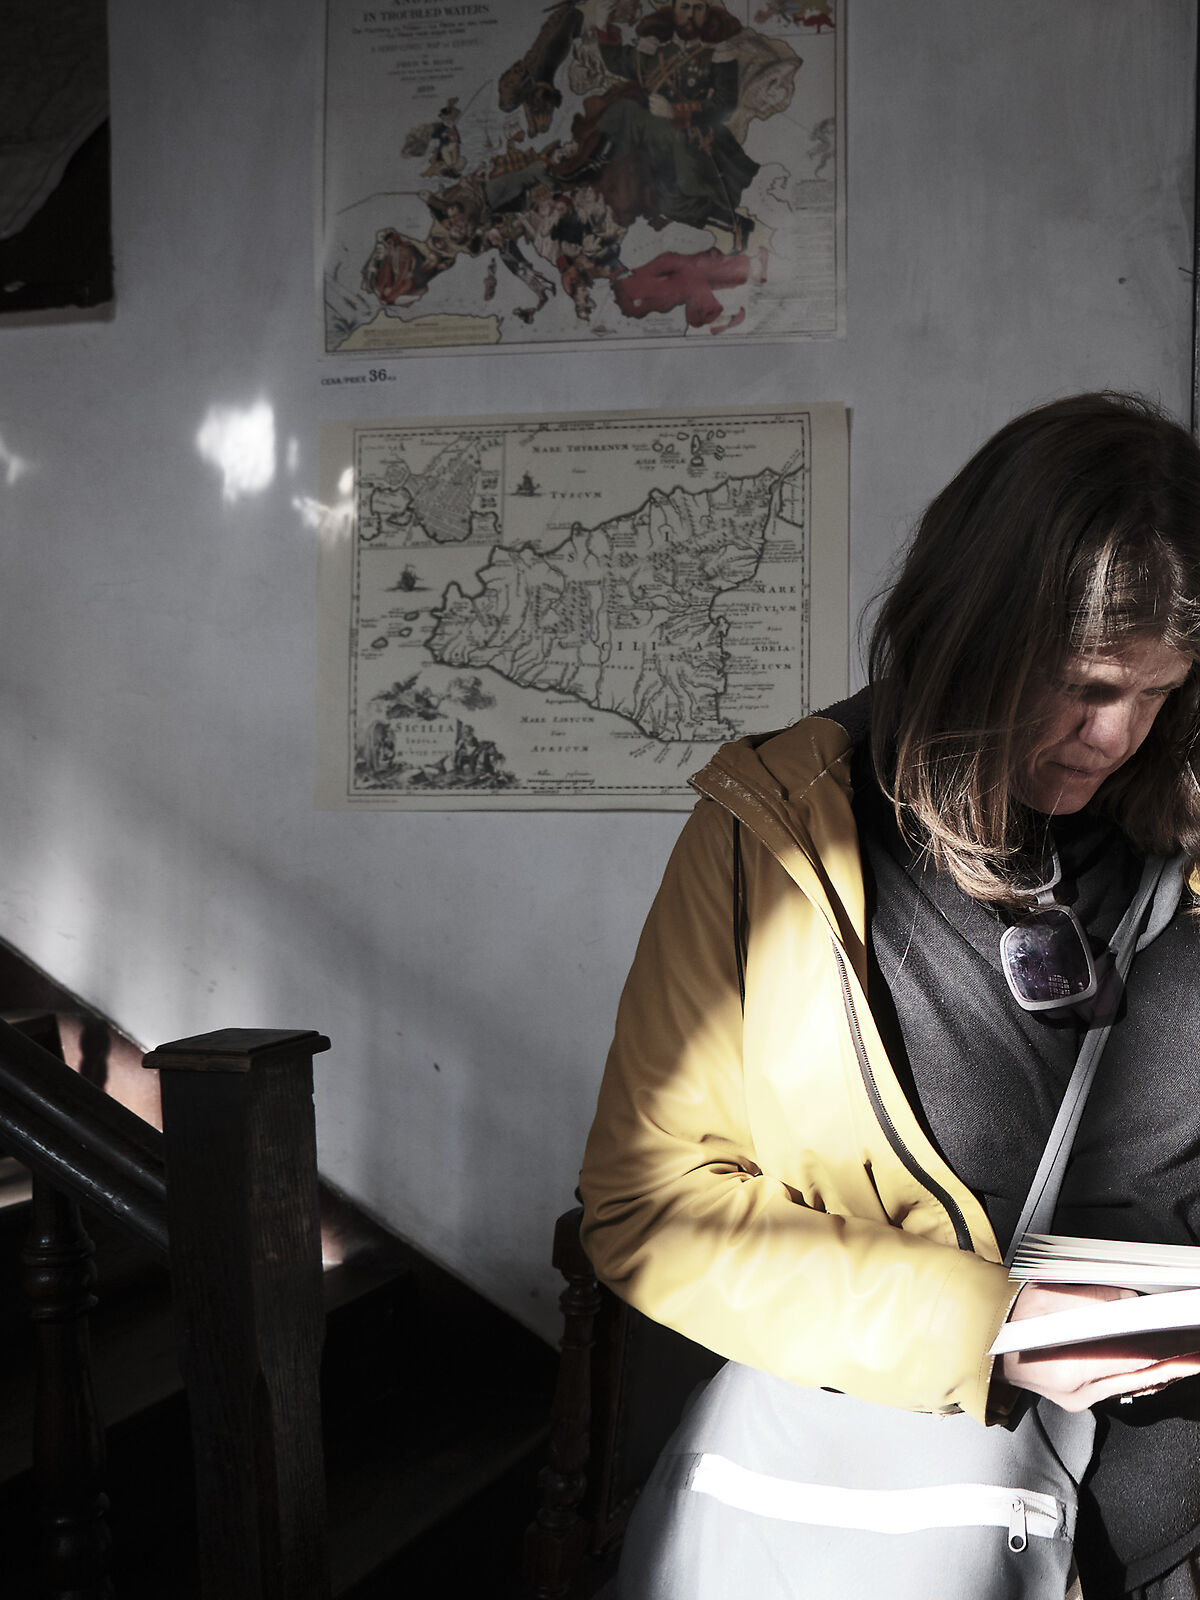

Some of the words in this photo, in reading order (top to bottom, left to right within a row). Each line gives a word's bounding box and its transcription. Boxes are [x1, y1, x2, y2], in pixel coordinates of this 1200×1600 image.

[363, 12, 376, 22] IN
[381, 8, 442, 20] TROUBLED
[444, 5, 489, 16] WATERS
[757, 584, 797, 594] MARE
[395, 722, 455, 733] SICILIA
